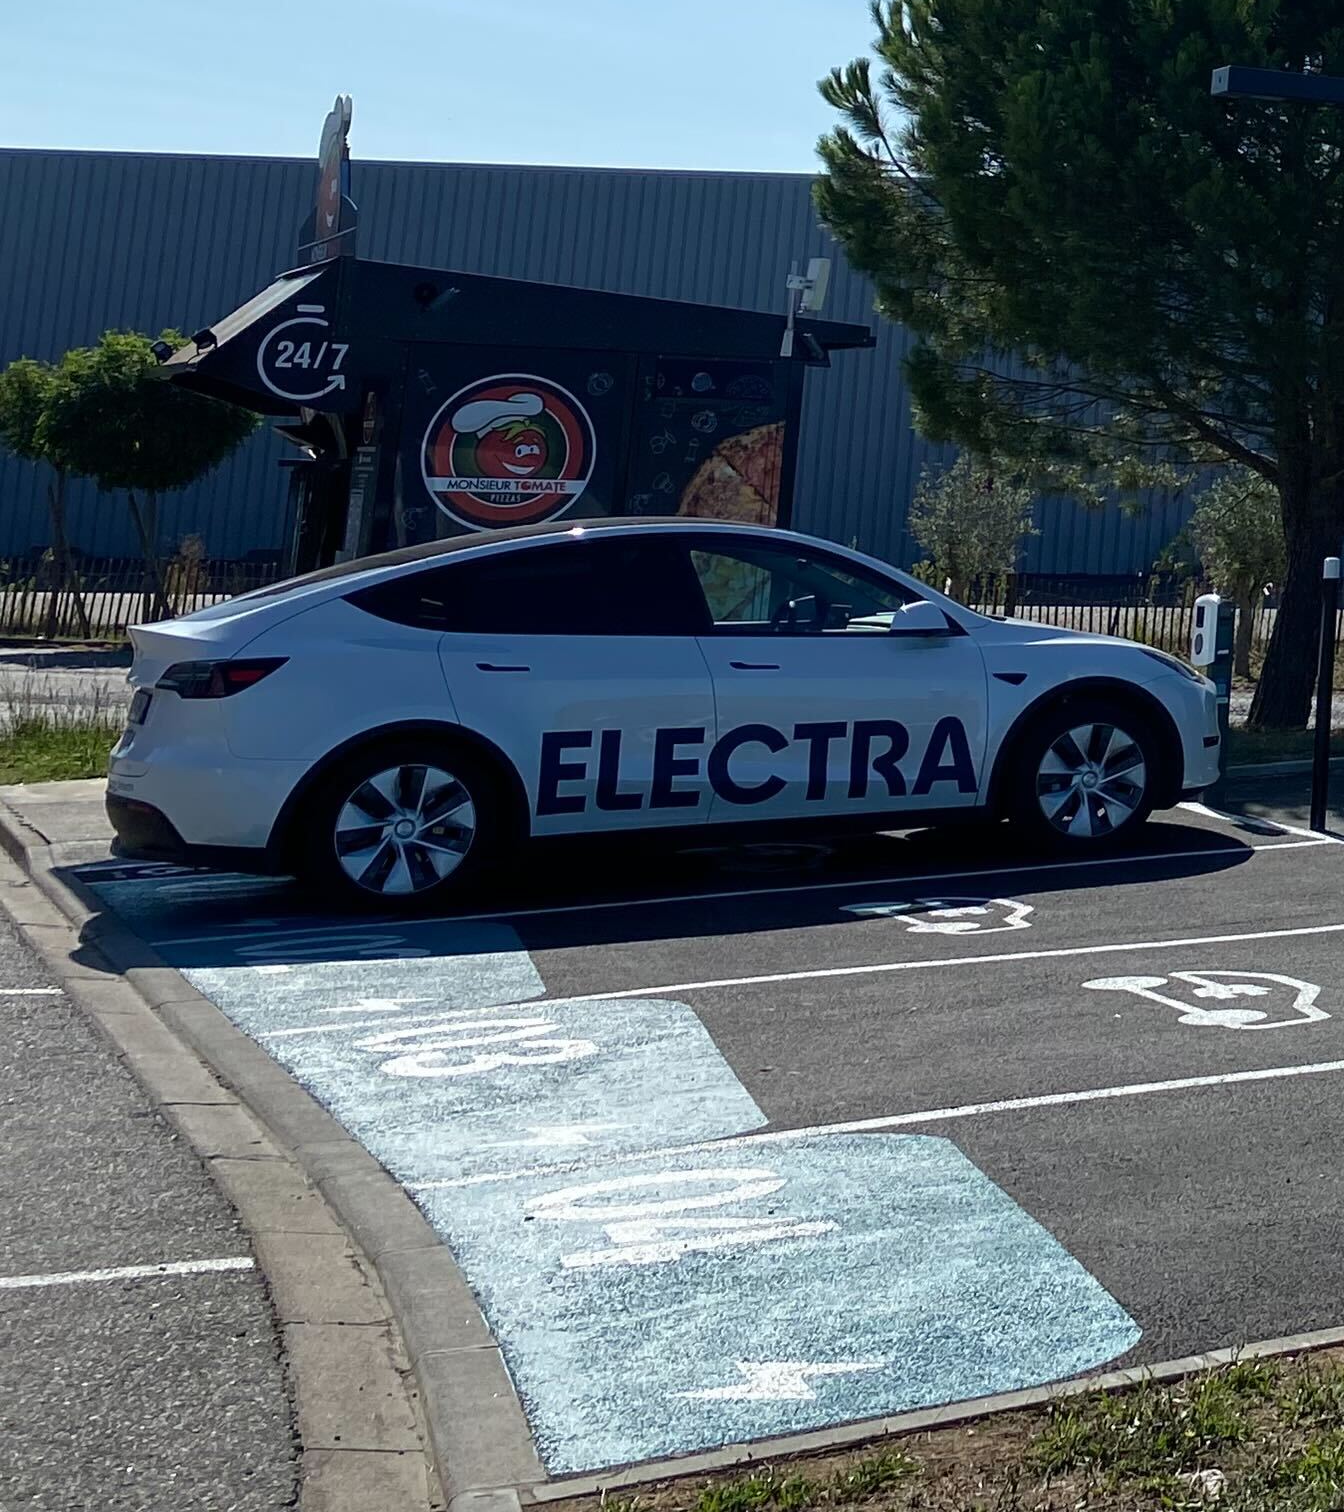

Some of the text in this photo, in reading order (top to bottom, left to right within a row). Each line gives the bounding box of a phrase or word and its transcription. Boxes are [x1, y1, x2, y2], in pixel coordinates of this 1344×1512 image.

[275, 341, 349, 370] 24/7
[446, 477, 566, 492] MONSIEUR TOMATE
[490, 494, 521, 503] PIZZAS
[536, 716, 978, 817] ELECTRA
[353, 1017, 599, 1078] 03
[526, 1166, 841, 1269] 04
